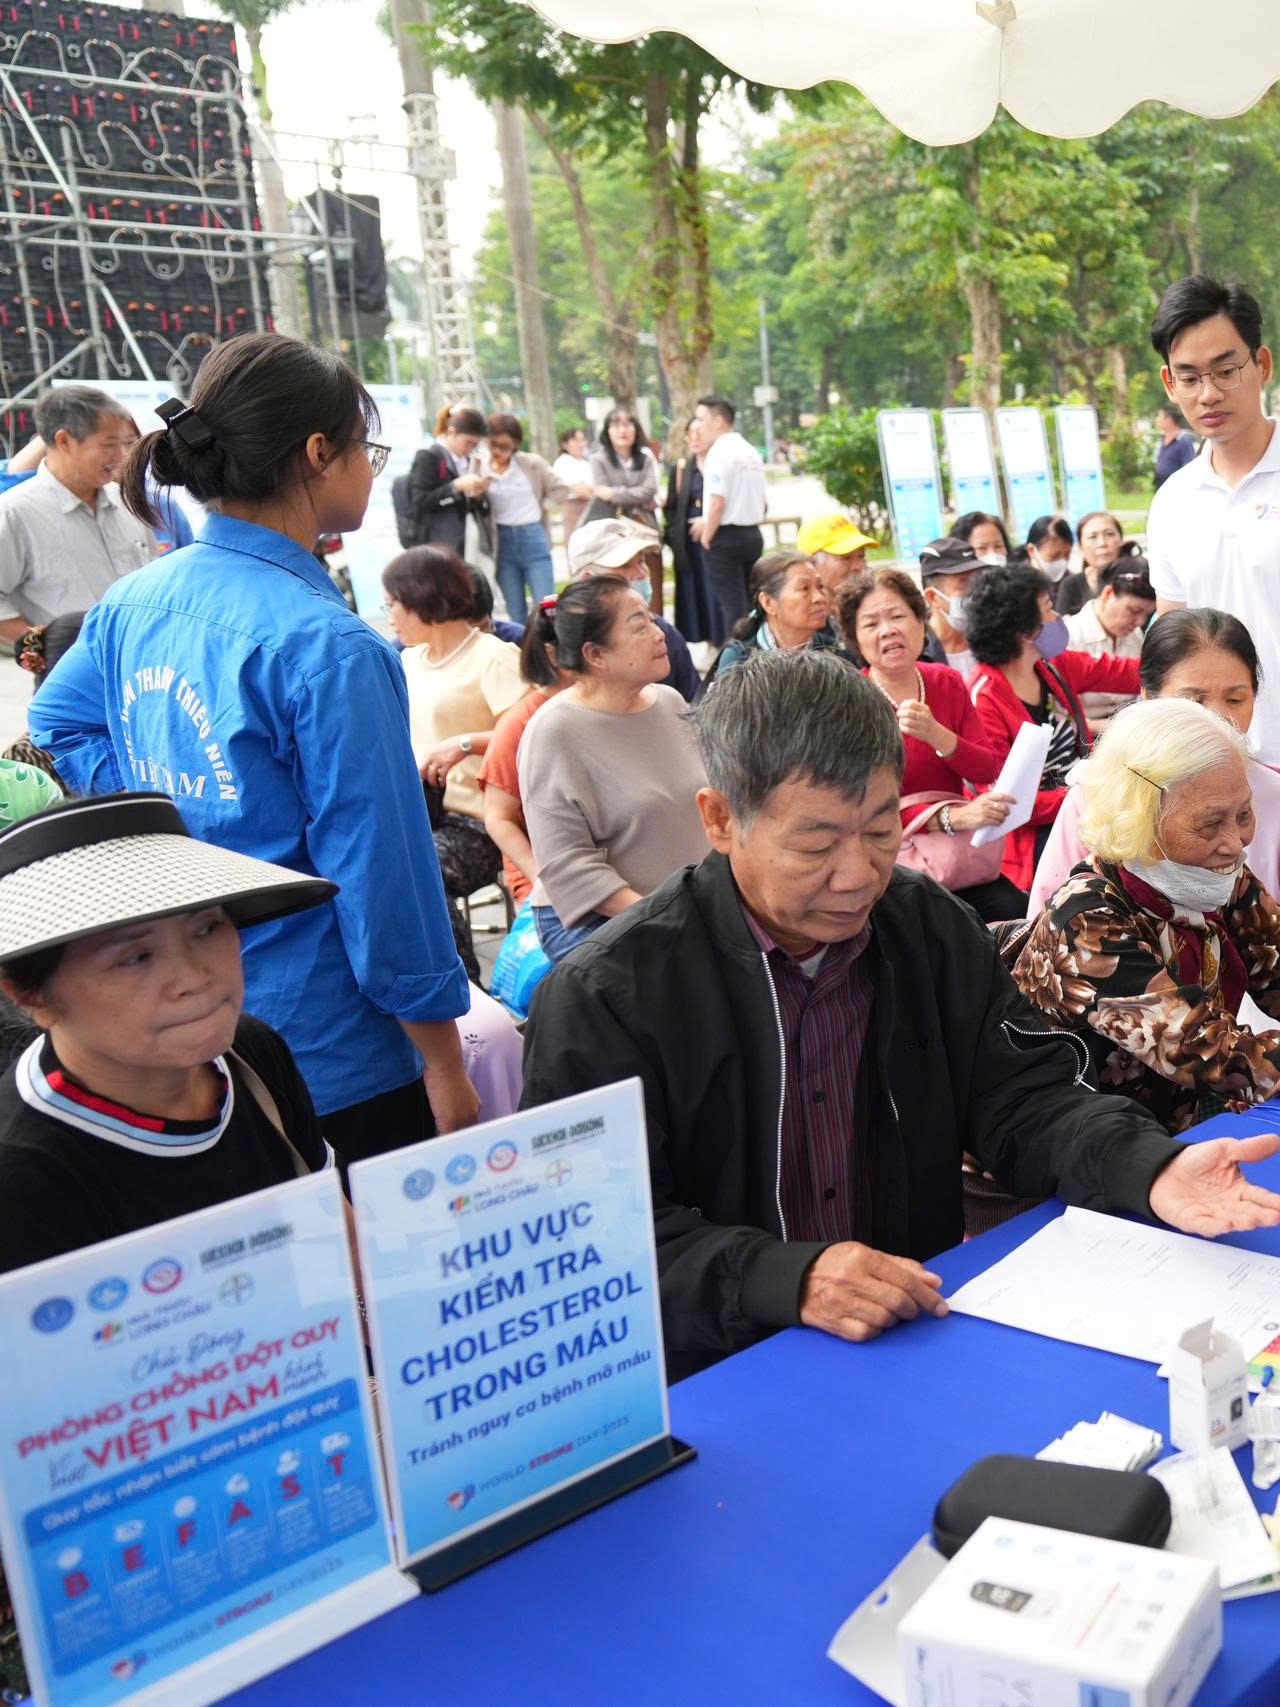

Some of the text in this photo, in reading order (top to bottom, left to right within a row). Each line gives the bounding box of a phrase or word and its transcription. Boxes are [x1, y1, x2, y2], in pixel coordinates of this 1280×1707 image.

[205, 743, 238, 801] NIÊN
[439, 1201, 594, 1279] KHU VỰC
[439, 1243, 603, 1325] KIỂM TRA
[400, 1270, 643, 1387] CHOLESTEROL
[424, 1314, 629, 1422] TRONG MÁU
[17, 1401, 125, 1459] PHÒNG
[233, 1338, 286, 1372] ĐỘT
[84, 1374, 281, 1470] VIỆT NAM
[407, 1431, 464, 1466] Tránh
[467, 1411, 512, 1439] nguy
[515, 1401, 537, 1418] cơ
[541, 1379, 583, 1406] bệnh
[617, 1349, 652, 1373] máu
[528, 1441, 575, 1471] STROKE
[63, 1570, 90, 1599] B
[121, 1543, 146, 1573] E
[176, 1520, 197, 1548] F
[227, 1497, 253, 1526] A
[278, 1474, 302, 1499] S
[327, 1451, 348, 1478] T
